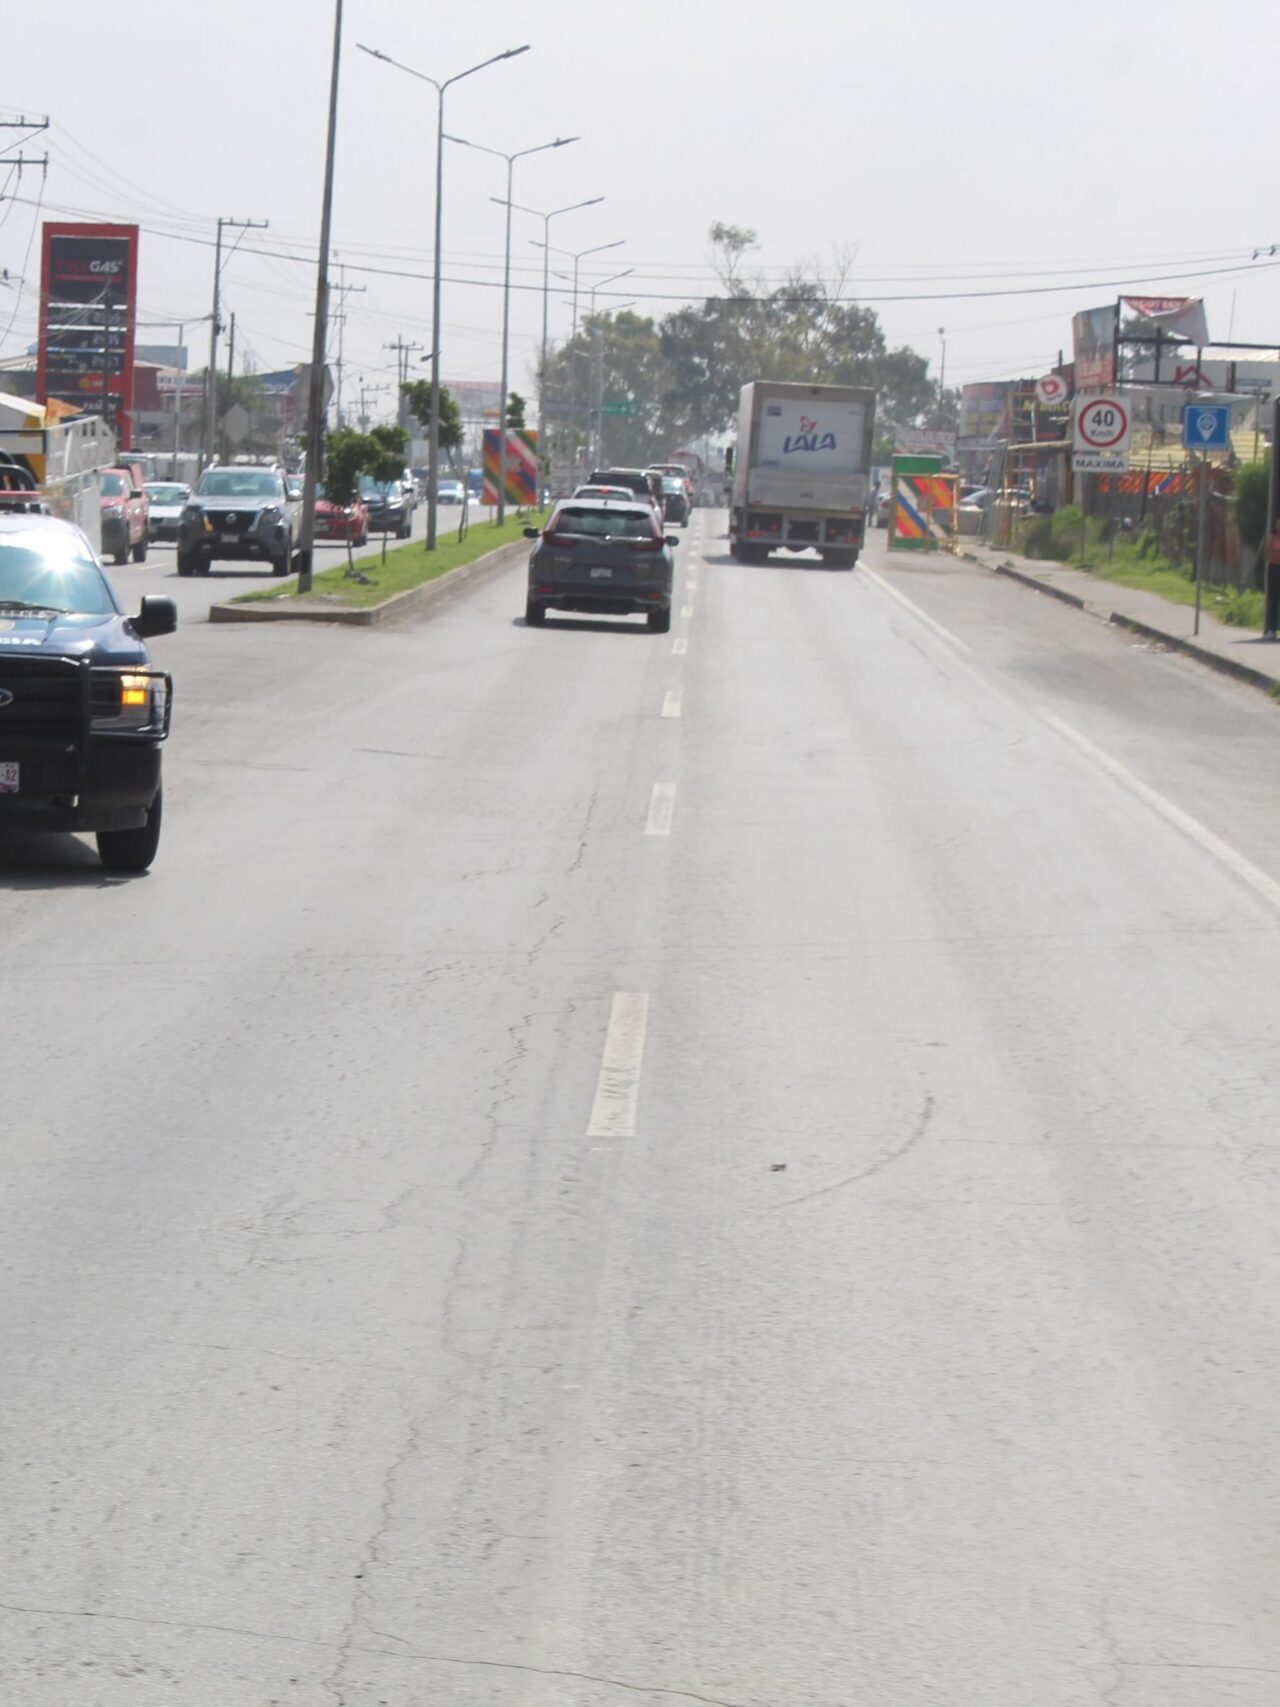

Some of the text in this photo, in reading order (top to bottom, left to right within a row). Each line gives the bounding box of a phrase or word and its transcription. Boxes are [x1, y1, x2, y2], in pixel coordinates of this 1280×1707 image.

[89, 260, 119, 273] GAS
[1091, 409, 1115, 428] 40
[783, 432, 837, 454] LALA
[1076, 460, 1125, 469] MAXIMA
